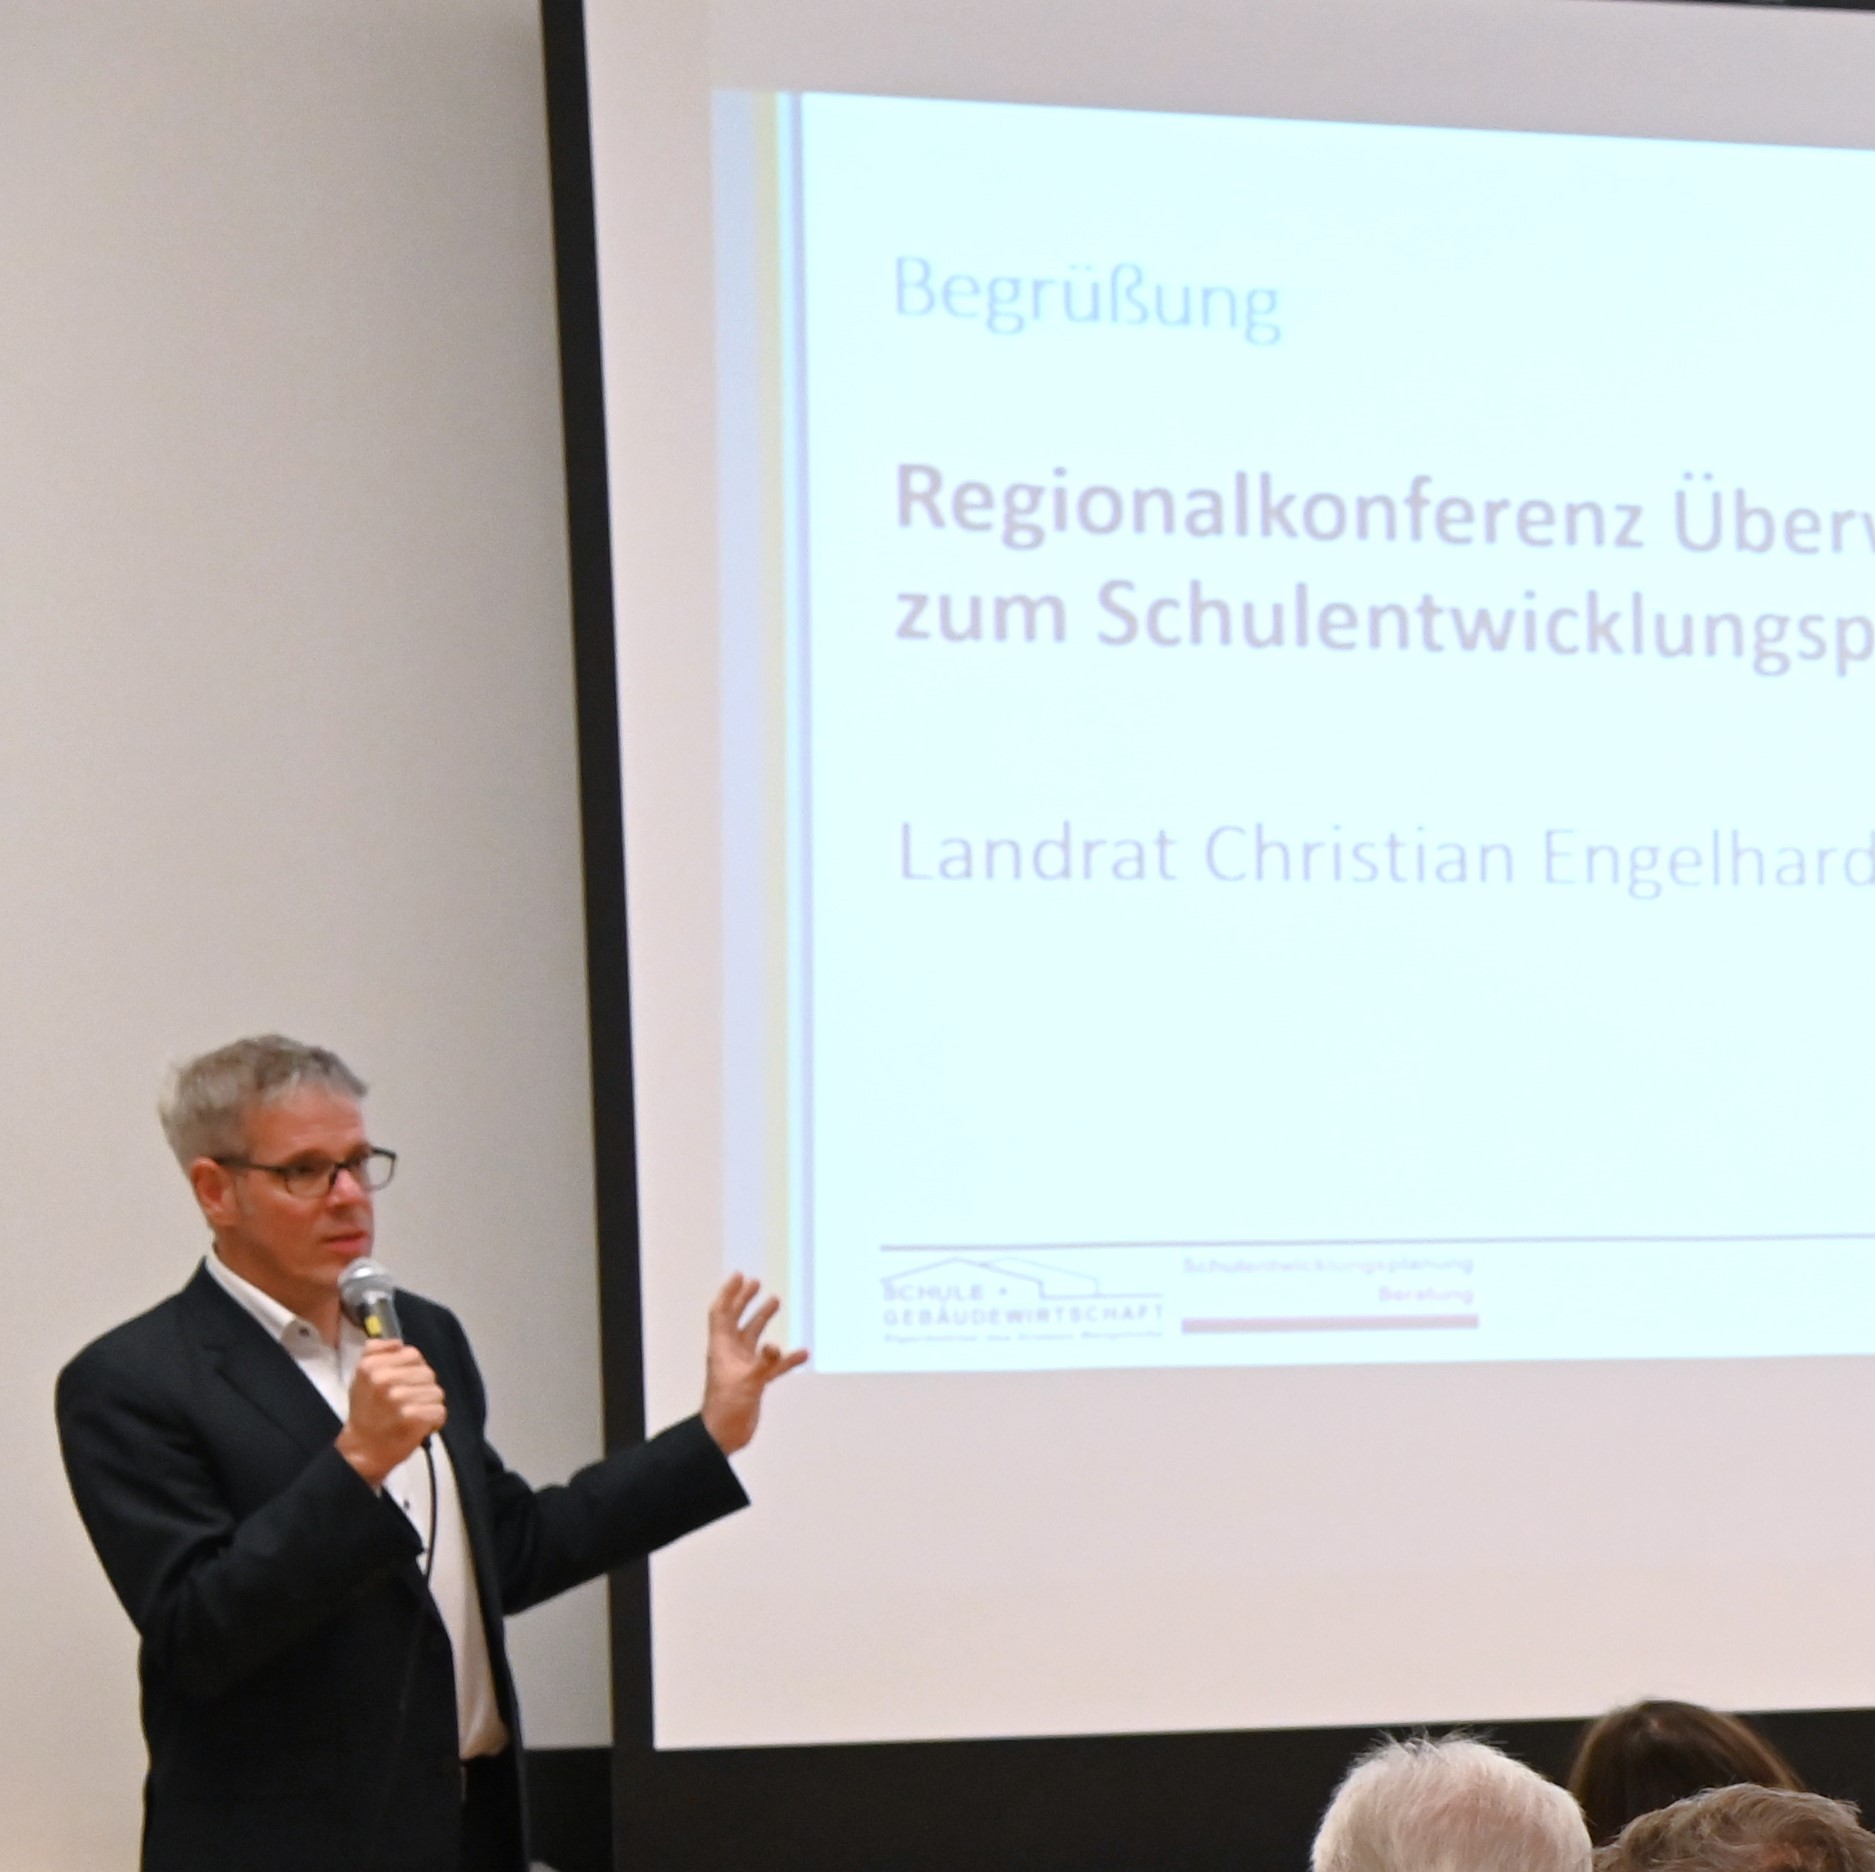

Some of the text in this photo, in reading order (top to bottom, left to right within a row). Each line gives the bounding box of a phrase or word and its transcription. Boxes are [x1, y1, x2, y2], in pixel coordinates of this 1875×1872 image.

[896, 256, 1283, 345] Begrüßung
[896, 462, 1645, 551] Regionalkonferenz
[895, 586, 1068, 643] zum
[899, 819, 1179, 882] Landrat
[1204, 822, 1515, 884] Christian
[883, 1284, 984, 1302] SCHULE
[884, 1303, 1164, 1327] GEBÄUDEWIRTSCHAFT
